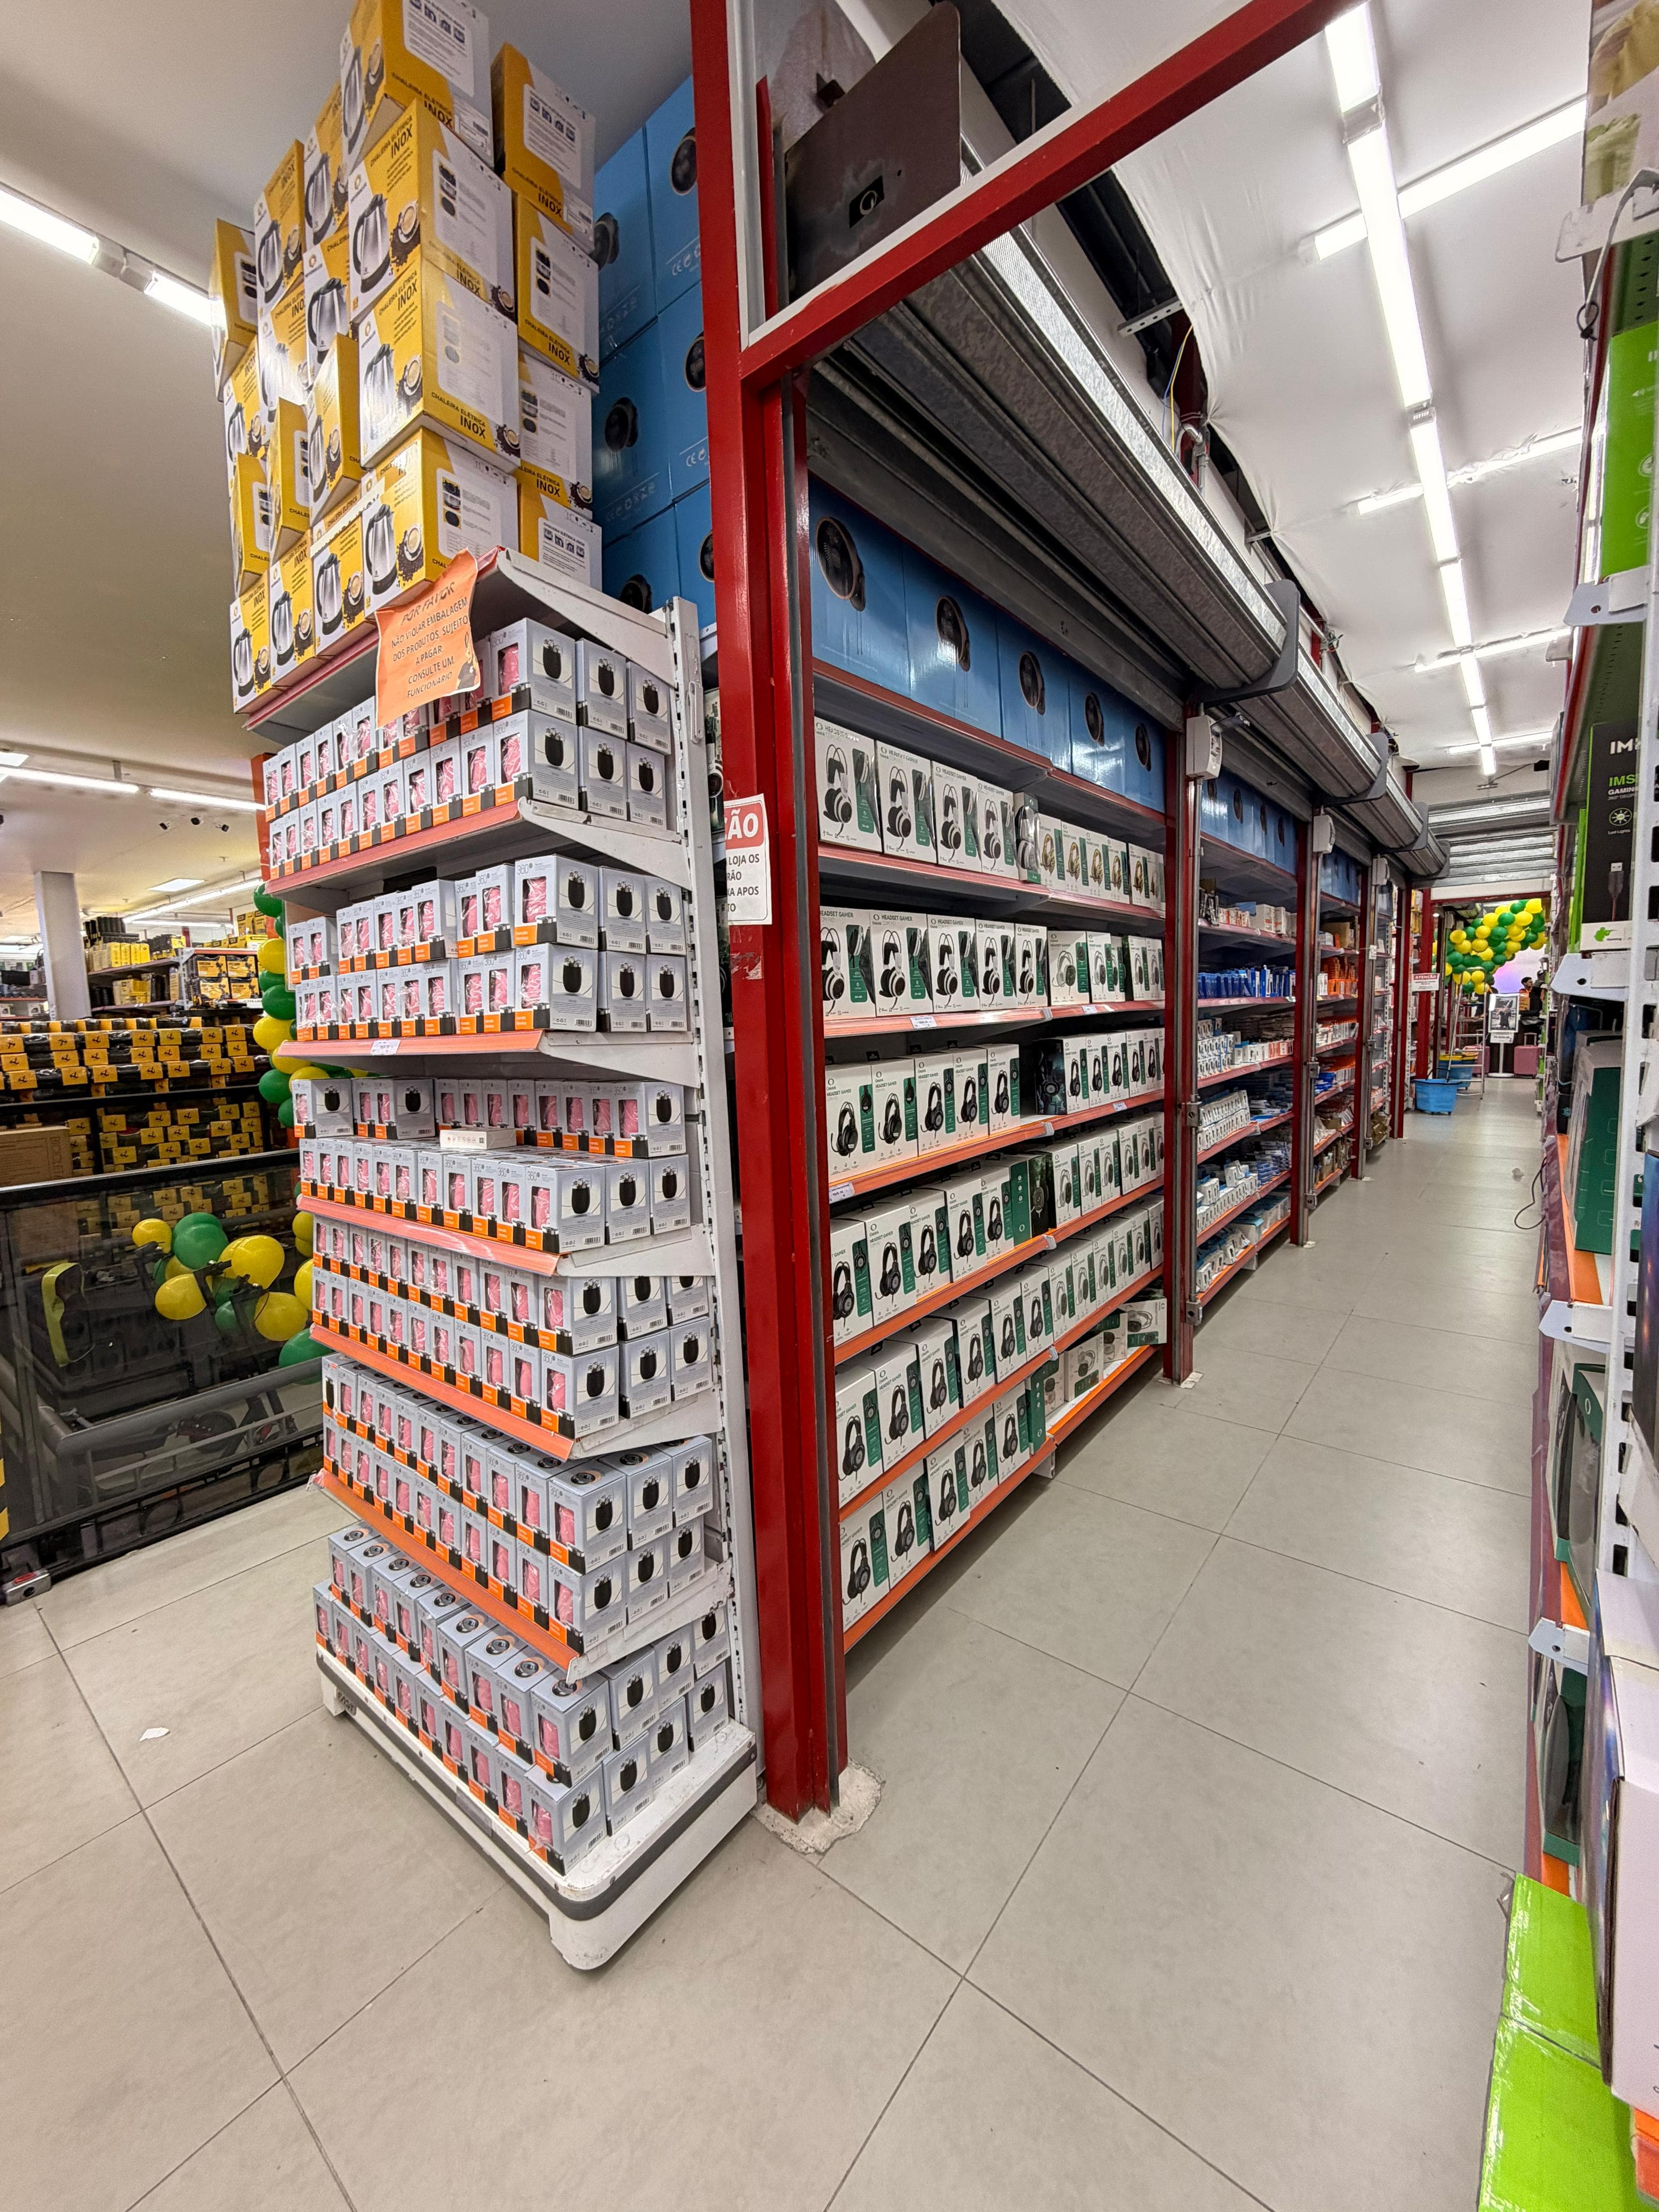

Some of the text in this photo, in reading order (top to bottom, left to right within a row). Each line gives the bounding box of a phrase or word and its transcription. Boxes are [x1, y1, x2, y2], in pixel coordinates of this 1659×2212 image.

[424, 100, 453, 131] INOX
[391, 123, 413, 158] INOX
[538, 192, 563, 219] INOX
[456, 271, 481, 296] INOX
[398, 279, 418, 310] INOX
[292, 297, 304, 318] INO
[548, 342, 571, 366] INOX
[431, 391, 486, 427] CHALEIRA ELÉTRICA
[459, 415, 486, 440] INOX
[536, 479, 560, 498] INOX
[537, 472, 560, 487] ELÉTRICA
[294, 547, 307, 568] INOX
[253, 589, 265, 609] INOX
[391, 597, 467, 648] NÃO VIOLAR EMBALAGEM
[401, 605, 421, 626] POR
[392, 649, 406, 662] DOS
[441, 615, 468, 636] SUJEITO
[408, 656, 454, 684] CONSULTE UM
[416, 655, 421, 665] A
[728, 853, 760, 867] LOJA OS
[736, 885, 759, 896] APOS
[921, 1348, 940, 1362] HEADSET GAMER
[879, 1375, 901, 1390] HEADSET GAMER
[845, 1403, 857, 1412] GAMER
[851, 1525, 862, 1535] GAMER
